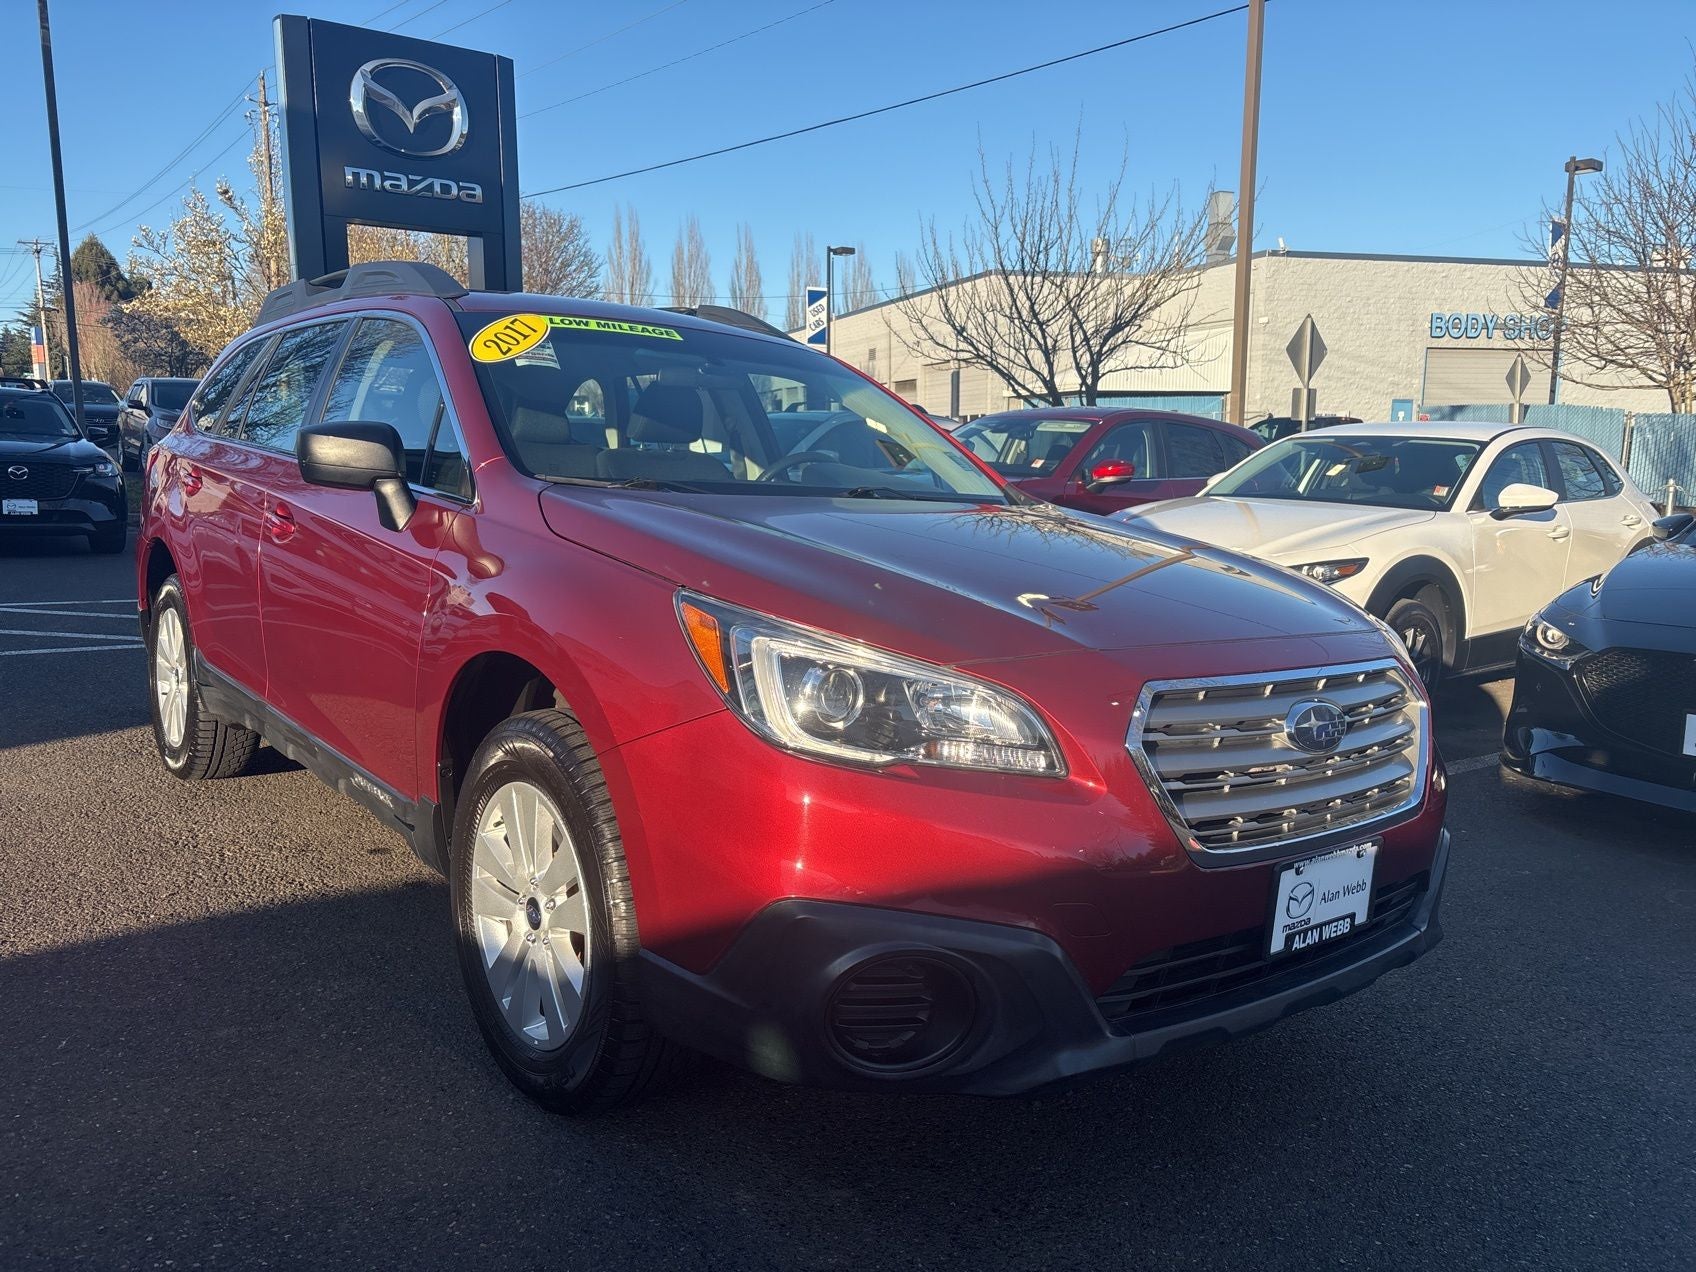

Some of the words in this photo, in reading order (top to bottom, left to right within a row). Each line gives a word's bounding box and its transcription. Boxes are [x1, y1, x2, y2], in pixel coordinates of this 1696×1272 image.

[344, 166, 483, 204] mazda
[809, 303, 825, 317] USED
[483, 318, 538, 356] 2017
[549, 317, 590, 328] LOW
[595, 321, 677, 338] MILEAGE
[809, 318, 825, 332] CARS
[1430, 312, 1498, 339] BODY
[1319, 889, 1340, 905] Alan
[1342, 879, 1367, 897] Webb
[1282, 917, 1311, 933] mazda
[1292, 928, 1320, 951] ALAN
[1321, 917, 1351, 941] WEBB
